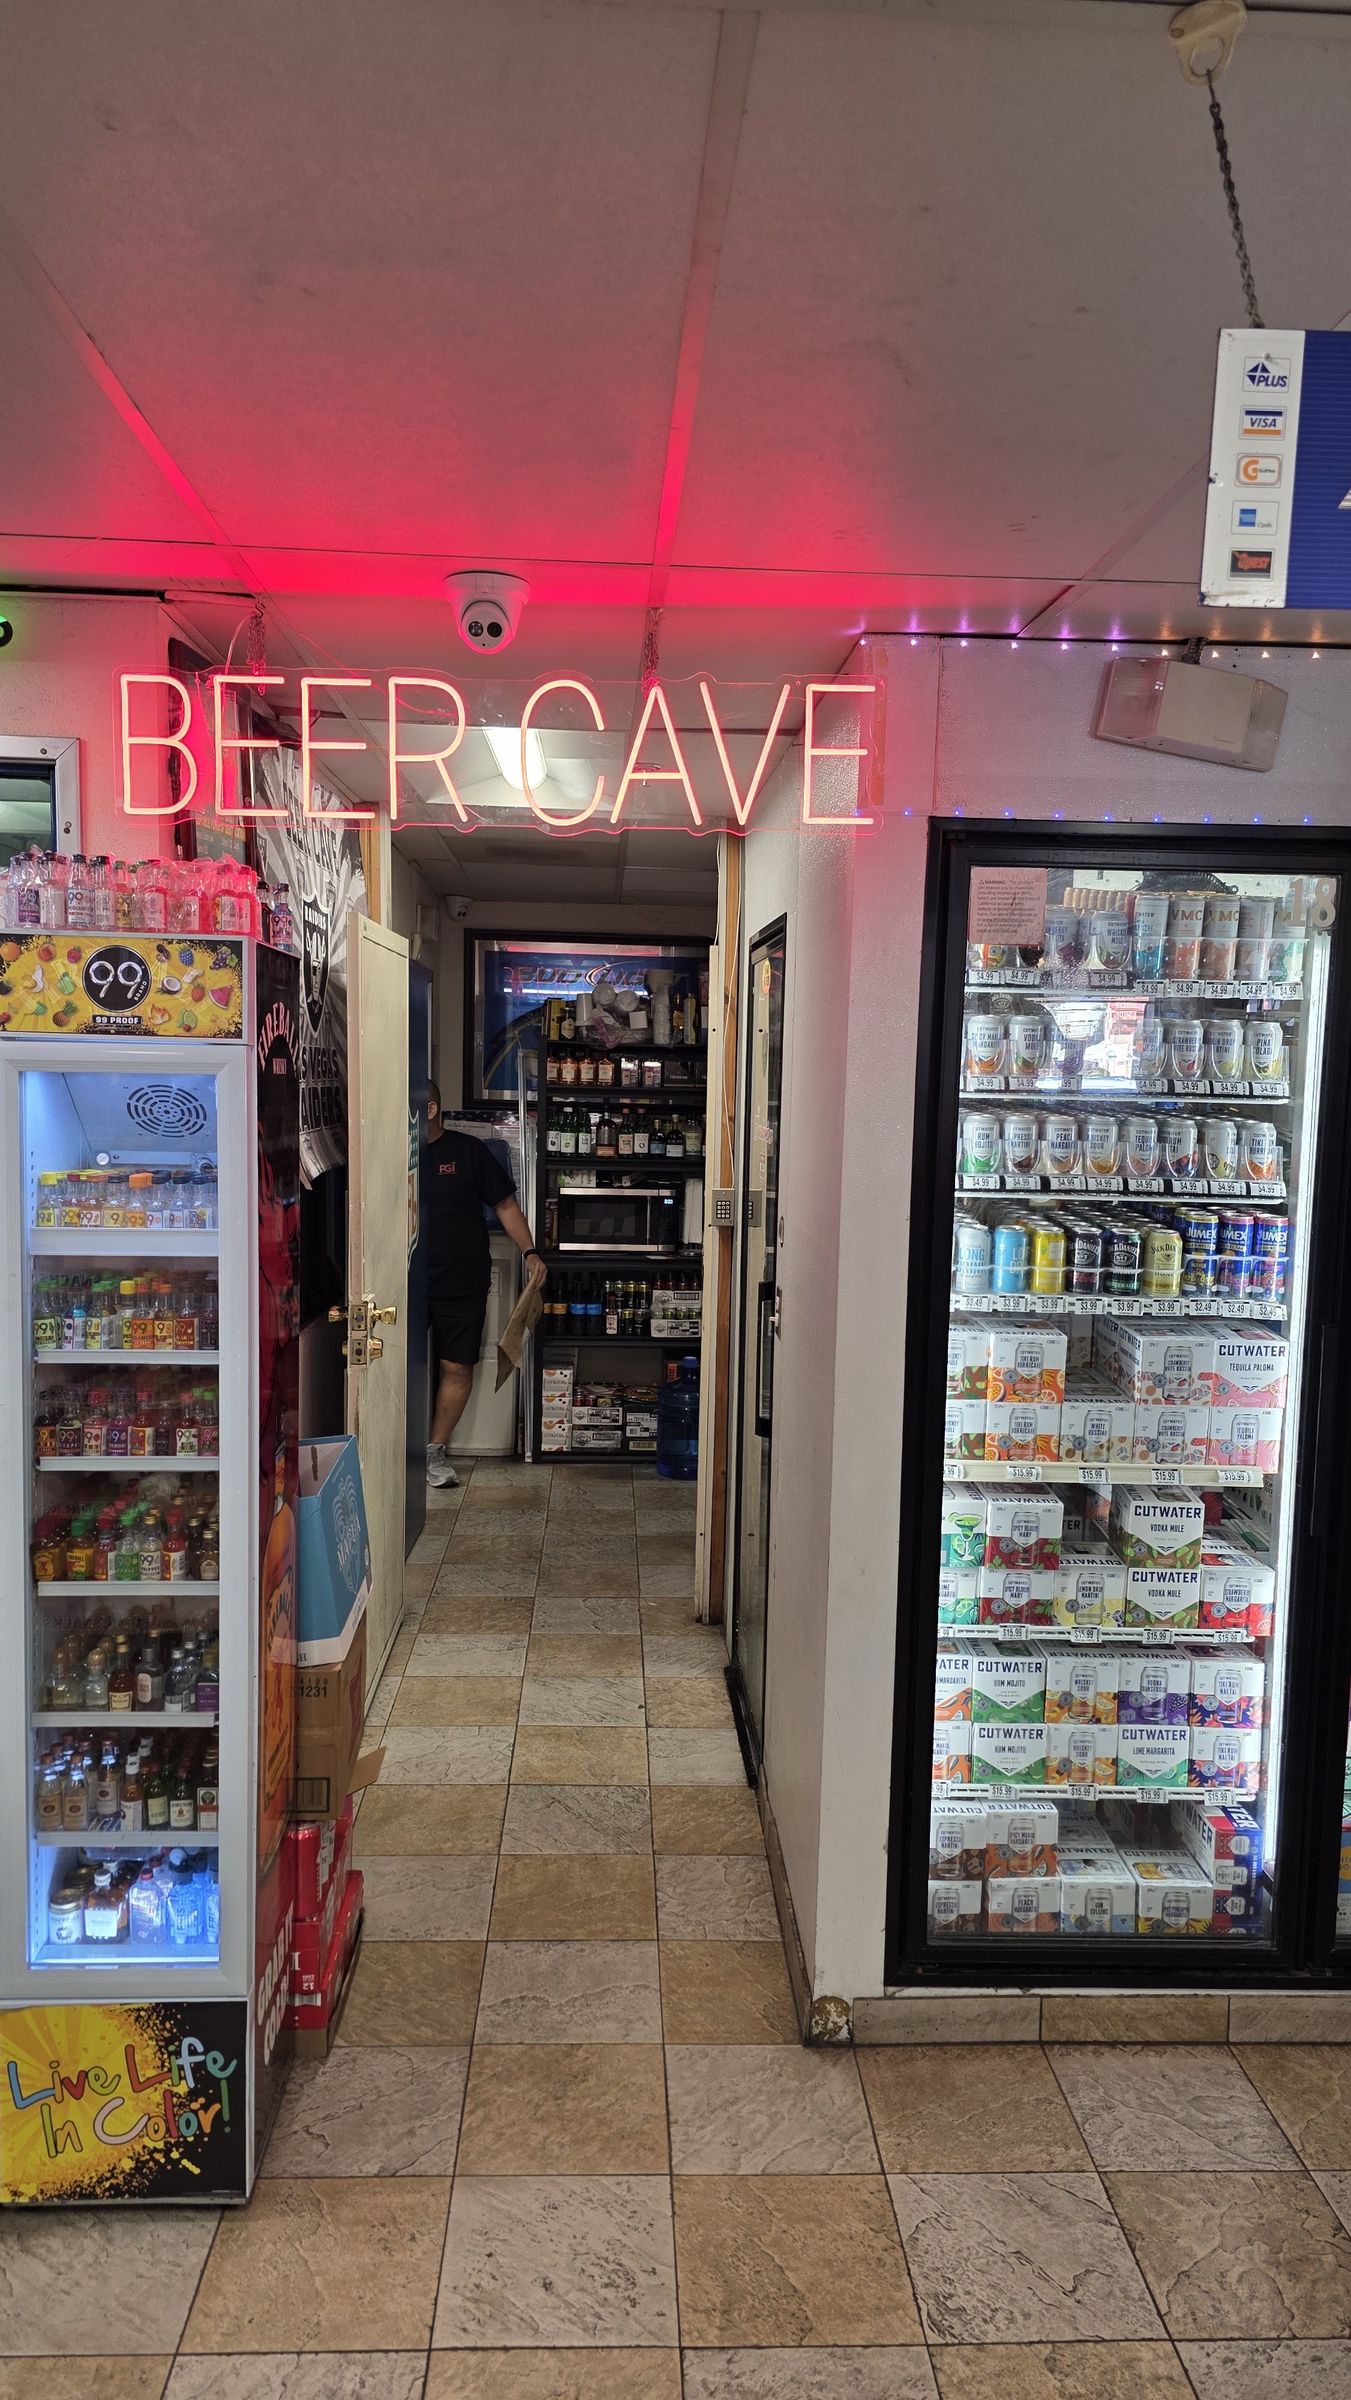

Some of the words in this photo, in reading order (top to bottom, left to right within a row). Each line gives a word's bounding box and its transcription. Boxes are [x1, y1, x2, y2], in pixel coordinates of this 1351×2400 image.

[1256, 375, 1288, 388] PLUS
[1250, 418, 1277, 428] VISA
[119, 674, 469, 822] BEER
[520, 677, 877, 826] CAVE
[1287, 876, 1336, 928] 18
[1171, 909, 1202, 921] VMC
[1208, 909, 1239, 921] VMC
[89, 960, 143, 999] 99
[134, 980, 148, 1001] BRAND
[95, 1016, 108, 1024] 99
[110, 1017, 140, 1025] PROOF
[308, 1046, 340, 1081] VEGAS
[977, 1078, 994, 1088] $4.99
[1017, 1078, 1034, 1087] $4.99
[1182, 1082, 1199, 1091] $4.99
[1220, 1082, 1238, 1092] $4.99
[1260, 1083, 1278, 1093] $4.99
[972, 1177, 990, 1187] $4.99
[1012, 1177, 1030, 1187] $4.99
[1058, 1177, 1075, 1187] $4.99
[1094, 1177, 1112, 1187] $4.99
[1135, 1179, 1153, 1189] $4.99
[1180, 1181, 1197, 1191] $4.99
[1218, 1181, 1235, 1190] $4.99
[1257, 1184, 1275, 1193] $4.99
[1186, 1227, 1217, 1239] JUMEX
[1256, 1228, 1288, 1240] JUMEX
[958, 1248, 985, 1261] LONG
[965, 1297, 983, 1307] $3.49
[1003, 1298, 1021, 1308] $3.99
[1041, 1299, 1059, 1309] $3.99
[1080, 1301, 1098, 1311] $3.99
[1117, 1301, 1134, 1312] $3.99
[1158, 1302, 1175, 1312] $3.99
[1194, 1302, 1212, 1312] $2.49
[1227, 1303, 1245, 1314] $2.49
[1259, 1306, 1277, 1317] $2.49
[1218, 1345, 1286, 1357] CUTWATER
[1229, 1363, 1252, 1371] TEQUILA
[1253, 1363, 1274, 1372] PALOMA
[1012, 1469, 1033, 1478] $15.99
[1082, 1470, 1102, 1480] $15.99
[1155, 1472, 1176, 1481] $15.99
[1224, 1472, 1245, 1481] $15.99
[1134, 1505, 1201, 1519] CUTWATER
[1150, 1523, 1168, 1533] VODKA
[1169, 1524, 1185, 1533] MULE
[140, 1554, 154, 1565] 99
[1132, 1571, 1198, 1583] CUTWATER
[1148, 1589, 1166, 1598] VODKA
[1166, 1589, 1182, 1598] MULE
[1002, 1628, 1022, 1638] $15.99
[1074, 1629, 1094, 1639] $15.99
[1146, 1631, 1167, 1641] $15.99
[1217, 1633, 1238, 1642] $15.99
[939, 1659, 969, 1670] ATER
[977, 1661, 1042, 1673] CUTWATER
[993, 1679, 1005, 1688] RUM
[1006, 1679, 1026, 1688] MOJITO
[978, 1727, 1044, 1740] CUTWATER
[1122, 1729, 1187, 1741] CUTWATER
[994, 1745, 1006, 1754] RUM
[1007, 1745, 1027, 1754] MOJITO
[1133, 1746, 1145, 1755] LIME
[1145, 1747, 1175, 1756] MARGARITA
[991, 1786, 1012, 1796] $15.99
[1070, 1788, 1091, 1797] $15.99
[1140, 1791, 1161, 1800] $15.99
[1207, 1792, 1228, 1802] $15.99
[933, 1806, 982, 1814] CUTWAT
[988, 1803, 1054, 1811] CUTWATER
[257, 1927, 285, 2026] GRAB
[7, 2060, 121, 2110] Live
[125, 2037, 238, 2093] Life
[40, 2103, 83, 2158] In
[93, 2079, 231, 2146] Color!
